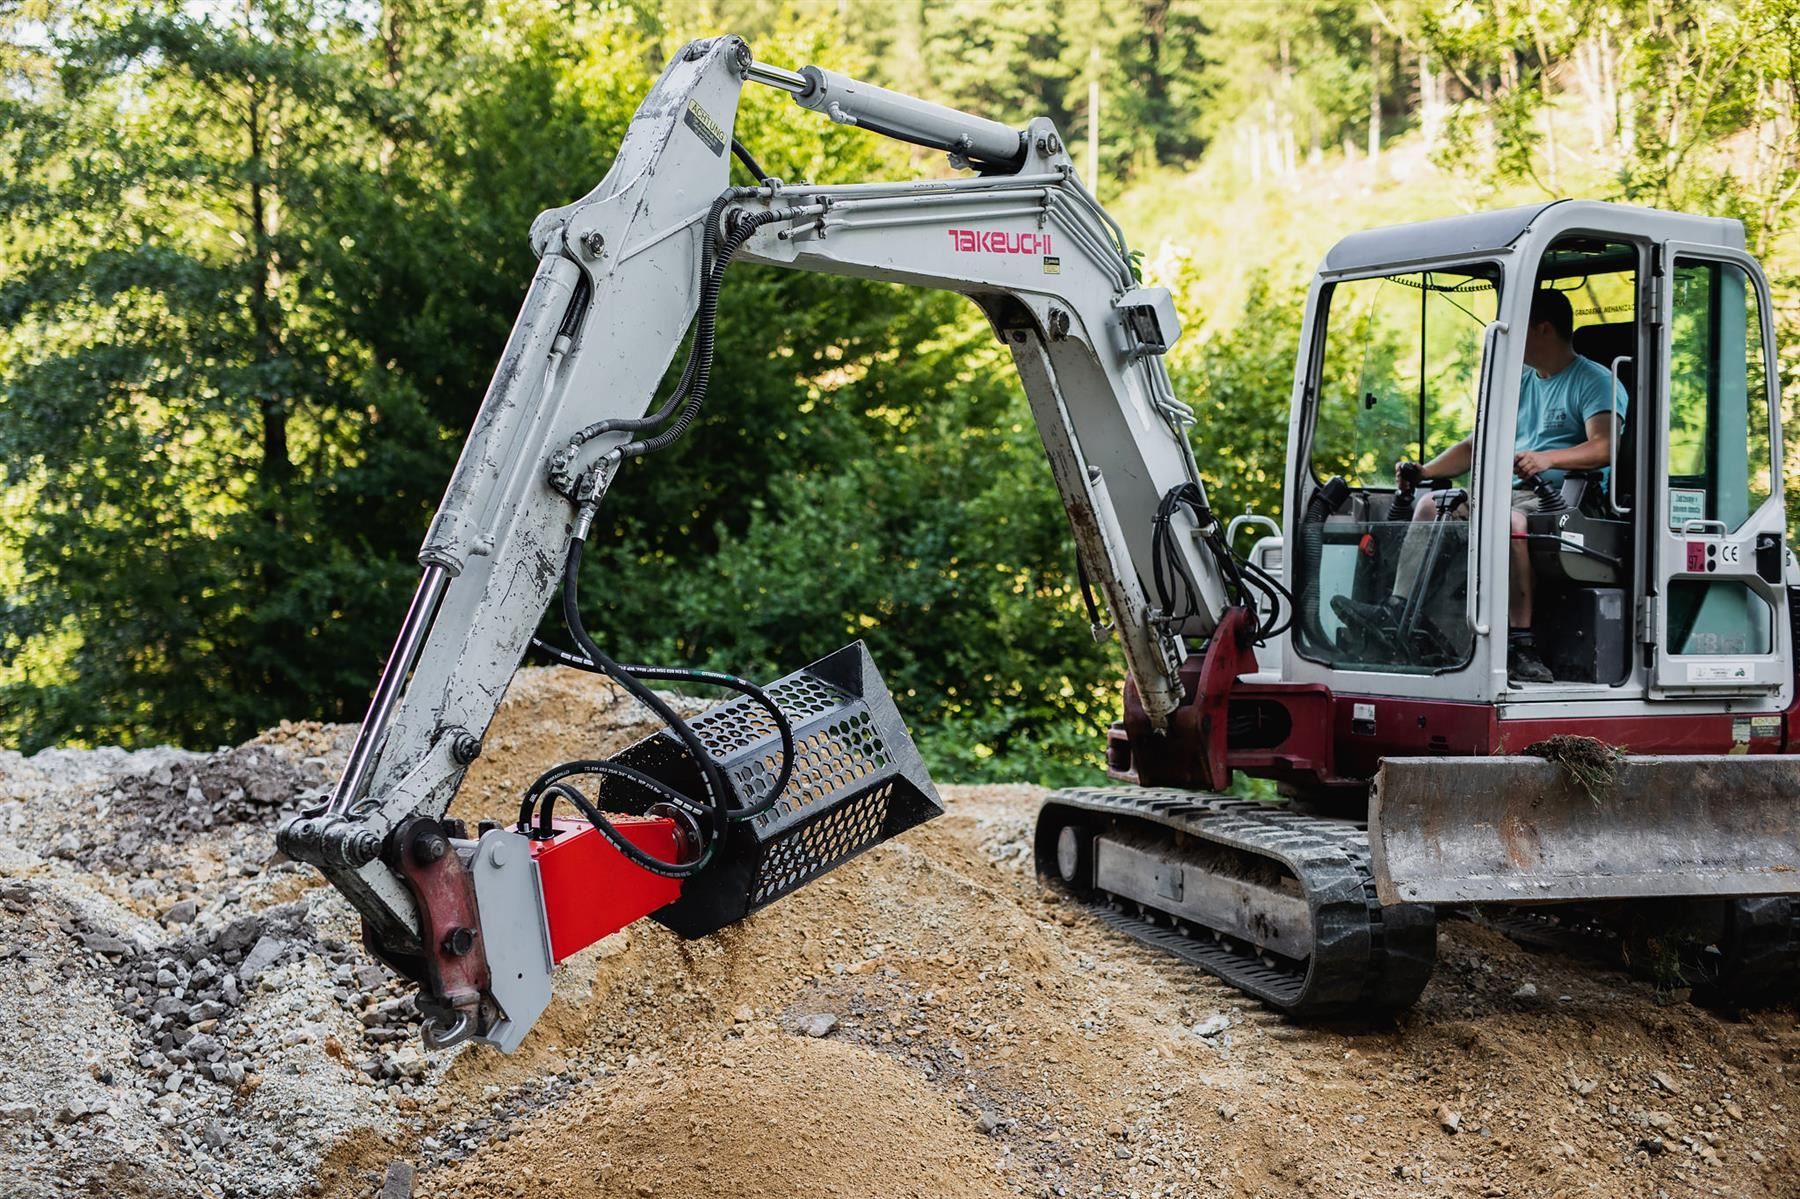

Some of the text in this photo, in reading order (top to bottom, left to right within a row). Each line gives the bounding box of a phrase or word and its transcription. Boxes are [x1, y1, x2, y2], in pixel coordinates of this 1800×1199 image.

[691, 104, 725, 141] ACHTUNG
[948, 229, 1052, 255] TAKEUCHI
[1688, 555, 1698, 570] 97
[1722, 545, 1739, 563] CE
